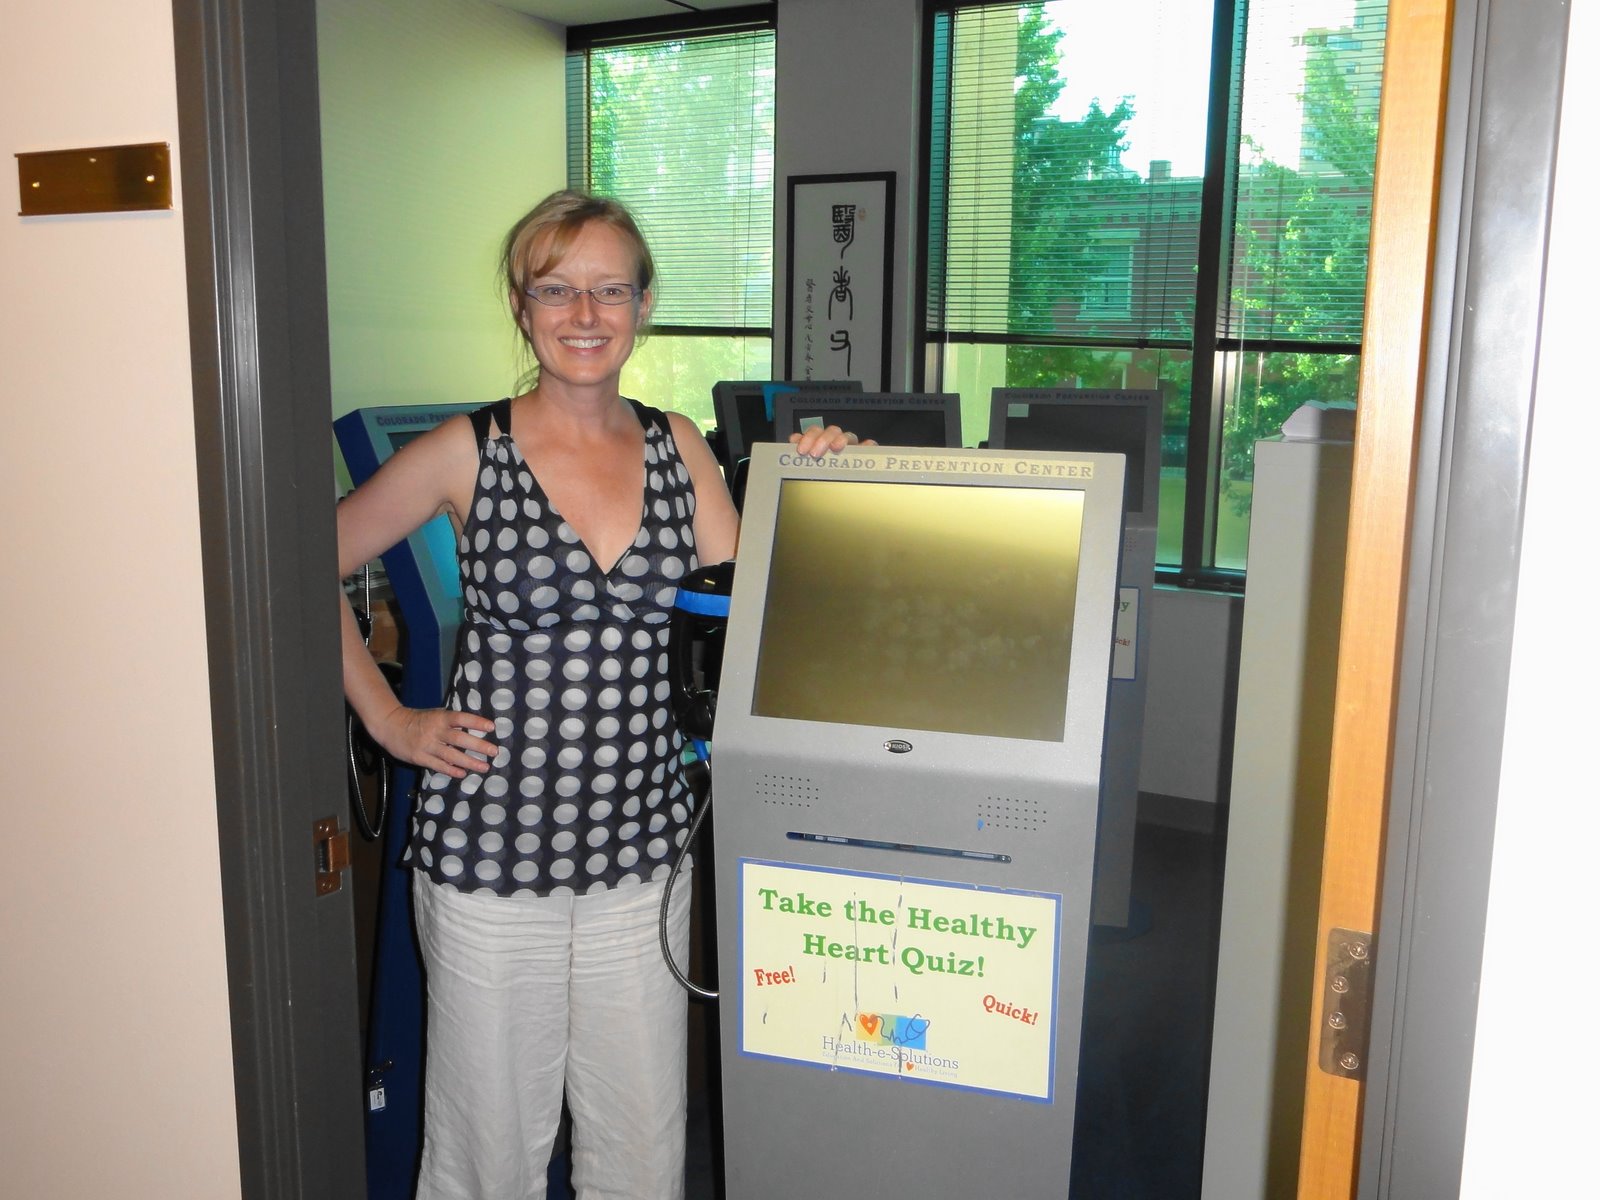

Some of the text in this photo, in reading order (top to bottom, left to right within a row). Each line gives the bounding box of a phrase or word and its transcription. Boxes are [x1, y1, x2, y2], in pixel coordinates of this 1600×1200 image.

[376, 415, 426, 426] COLORADO
[779, 453, 1093, 478] COLORADO PREVENTION CENTER
[758, 888, 1037, 949] Take the Healthy
[802, 933, 985, 978] Heart Quiz!
[753, 965, 796, 987] Free!
[982, 994, 1039, 1026] Quick!
[822, 1036, 960, 1070] Health-e-Solutions
